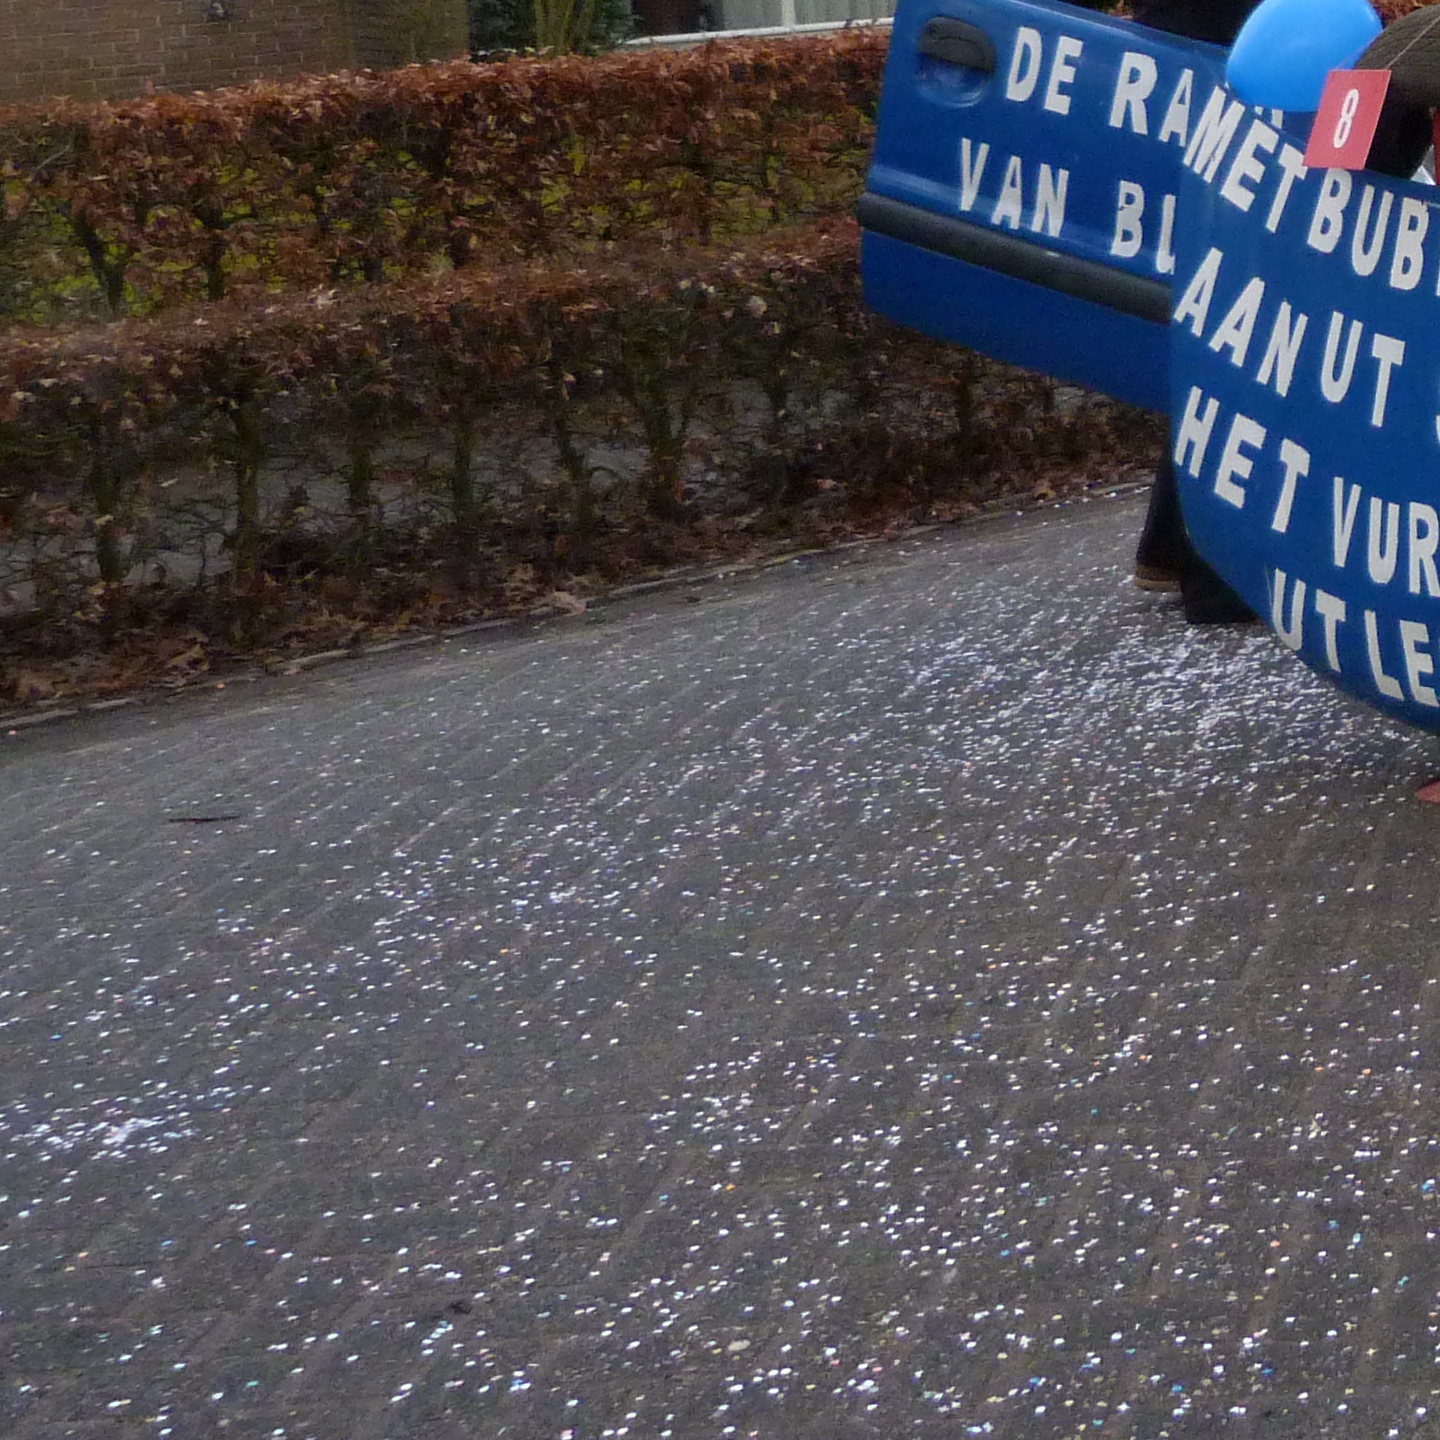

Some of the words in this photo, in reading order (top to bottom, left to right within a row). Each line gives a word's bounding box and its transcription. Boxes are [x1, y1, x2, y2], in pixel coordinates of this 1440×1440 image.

[1006, 26, 1084, 115] DE
[1109, 51, 1194, 148] RA
[1332, 88, 1359, 149] 8
[960, 137, 1069, 238] VAN
[1111, 179, 1176, 276] BL
[1183, 85, 1307, 234] MET
[1173, 247, 1309, 398] AAN
[1320, 311, 1406, 429] UT
[1174, 386, 1311, 534] HET
[1271, 566, 1347, 673] UT
